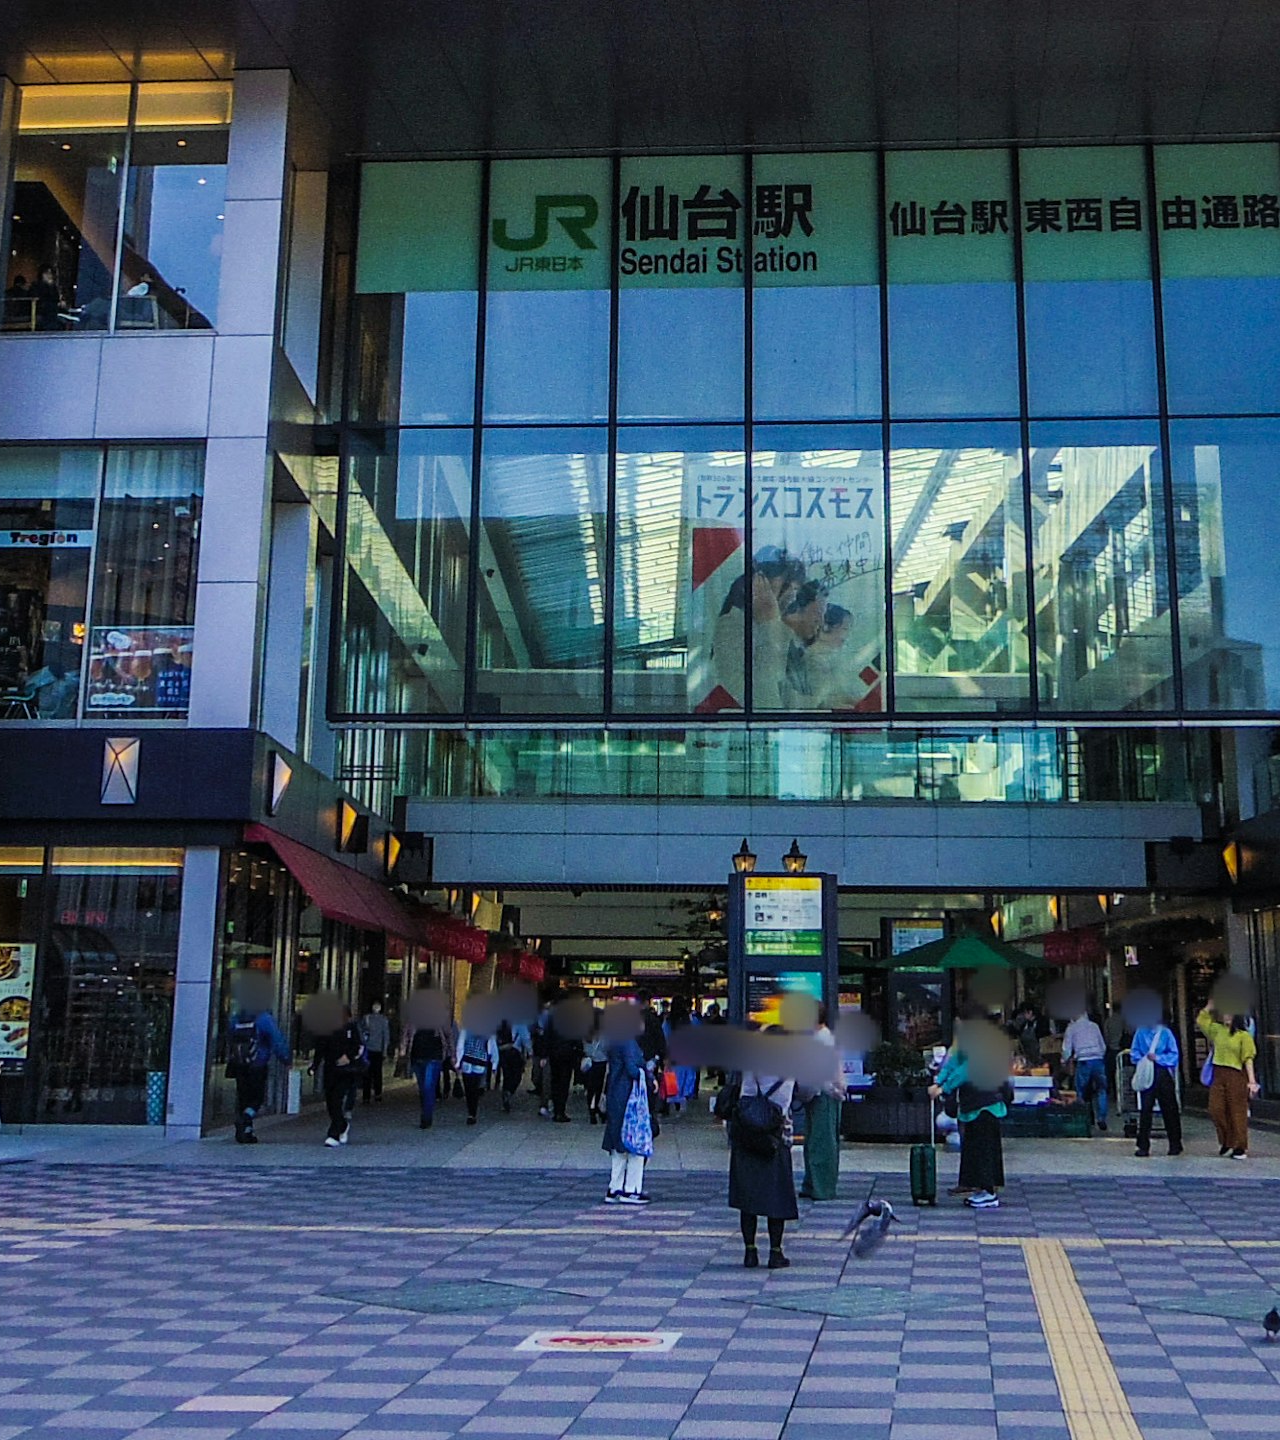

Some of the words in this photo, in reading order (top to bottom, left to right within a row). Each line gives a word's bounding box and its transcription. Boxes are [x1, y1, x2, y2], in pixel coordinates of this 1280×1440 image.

[492, 194, 599, 252] JR
[621, 184, 815, 241] 仙台駅
[505, 256, 584, 273] JR東日本
[620, 247, 708, 274] Sendai
[716, 245, 818, 273] Station
[696, 484, 875, 519] トランスコスモス
